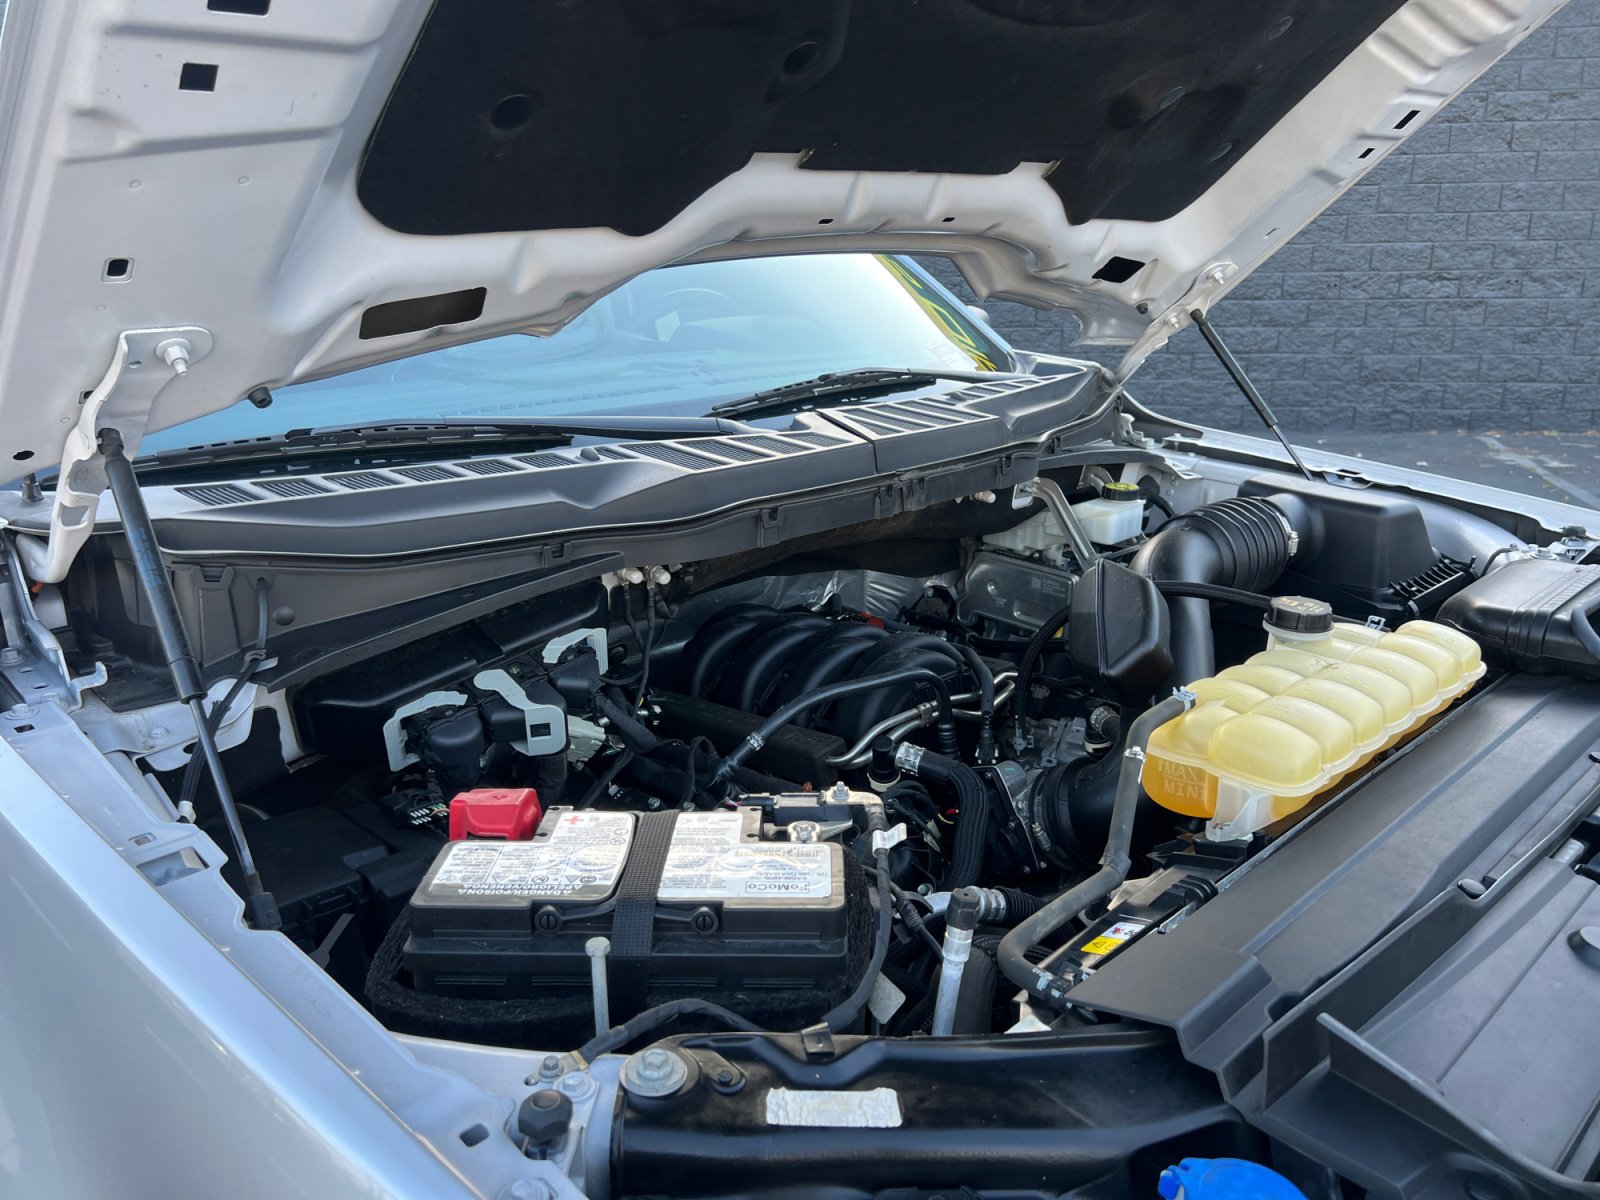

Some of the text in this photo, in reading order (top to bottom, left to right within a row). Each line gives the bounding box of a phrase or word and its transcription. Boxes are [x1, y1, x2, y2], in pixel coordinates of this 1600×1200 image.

[1164, 760, 1199, 781] MAX
[1163, 779, 1199, 800] MIN
[748, 882, 808, 891] FoMoCo
